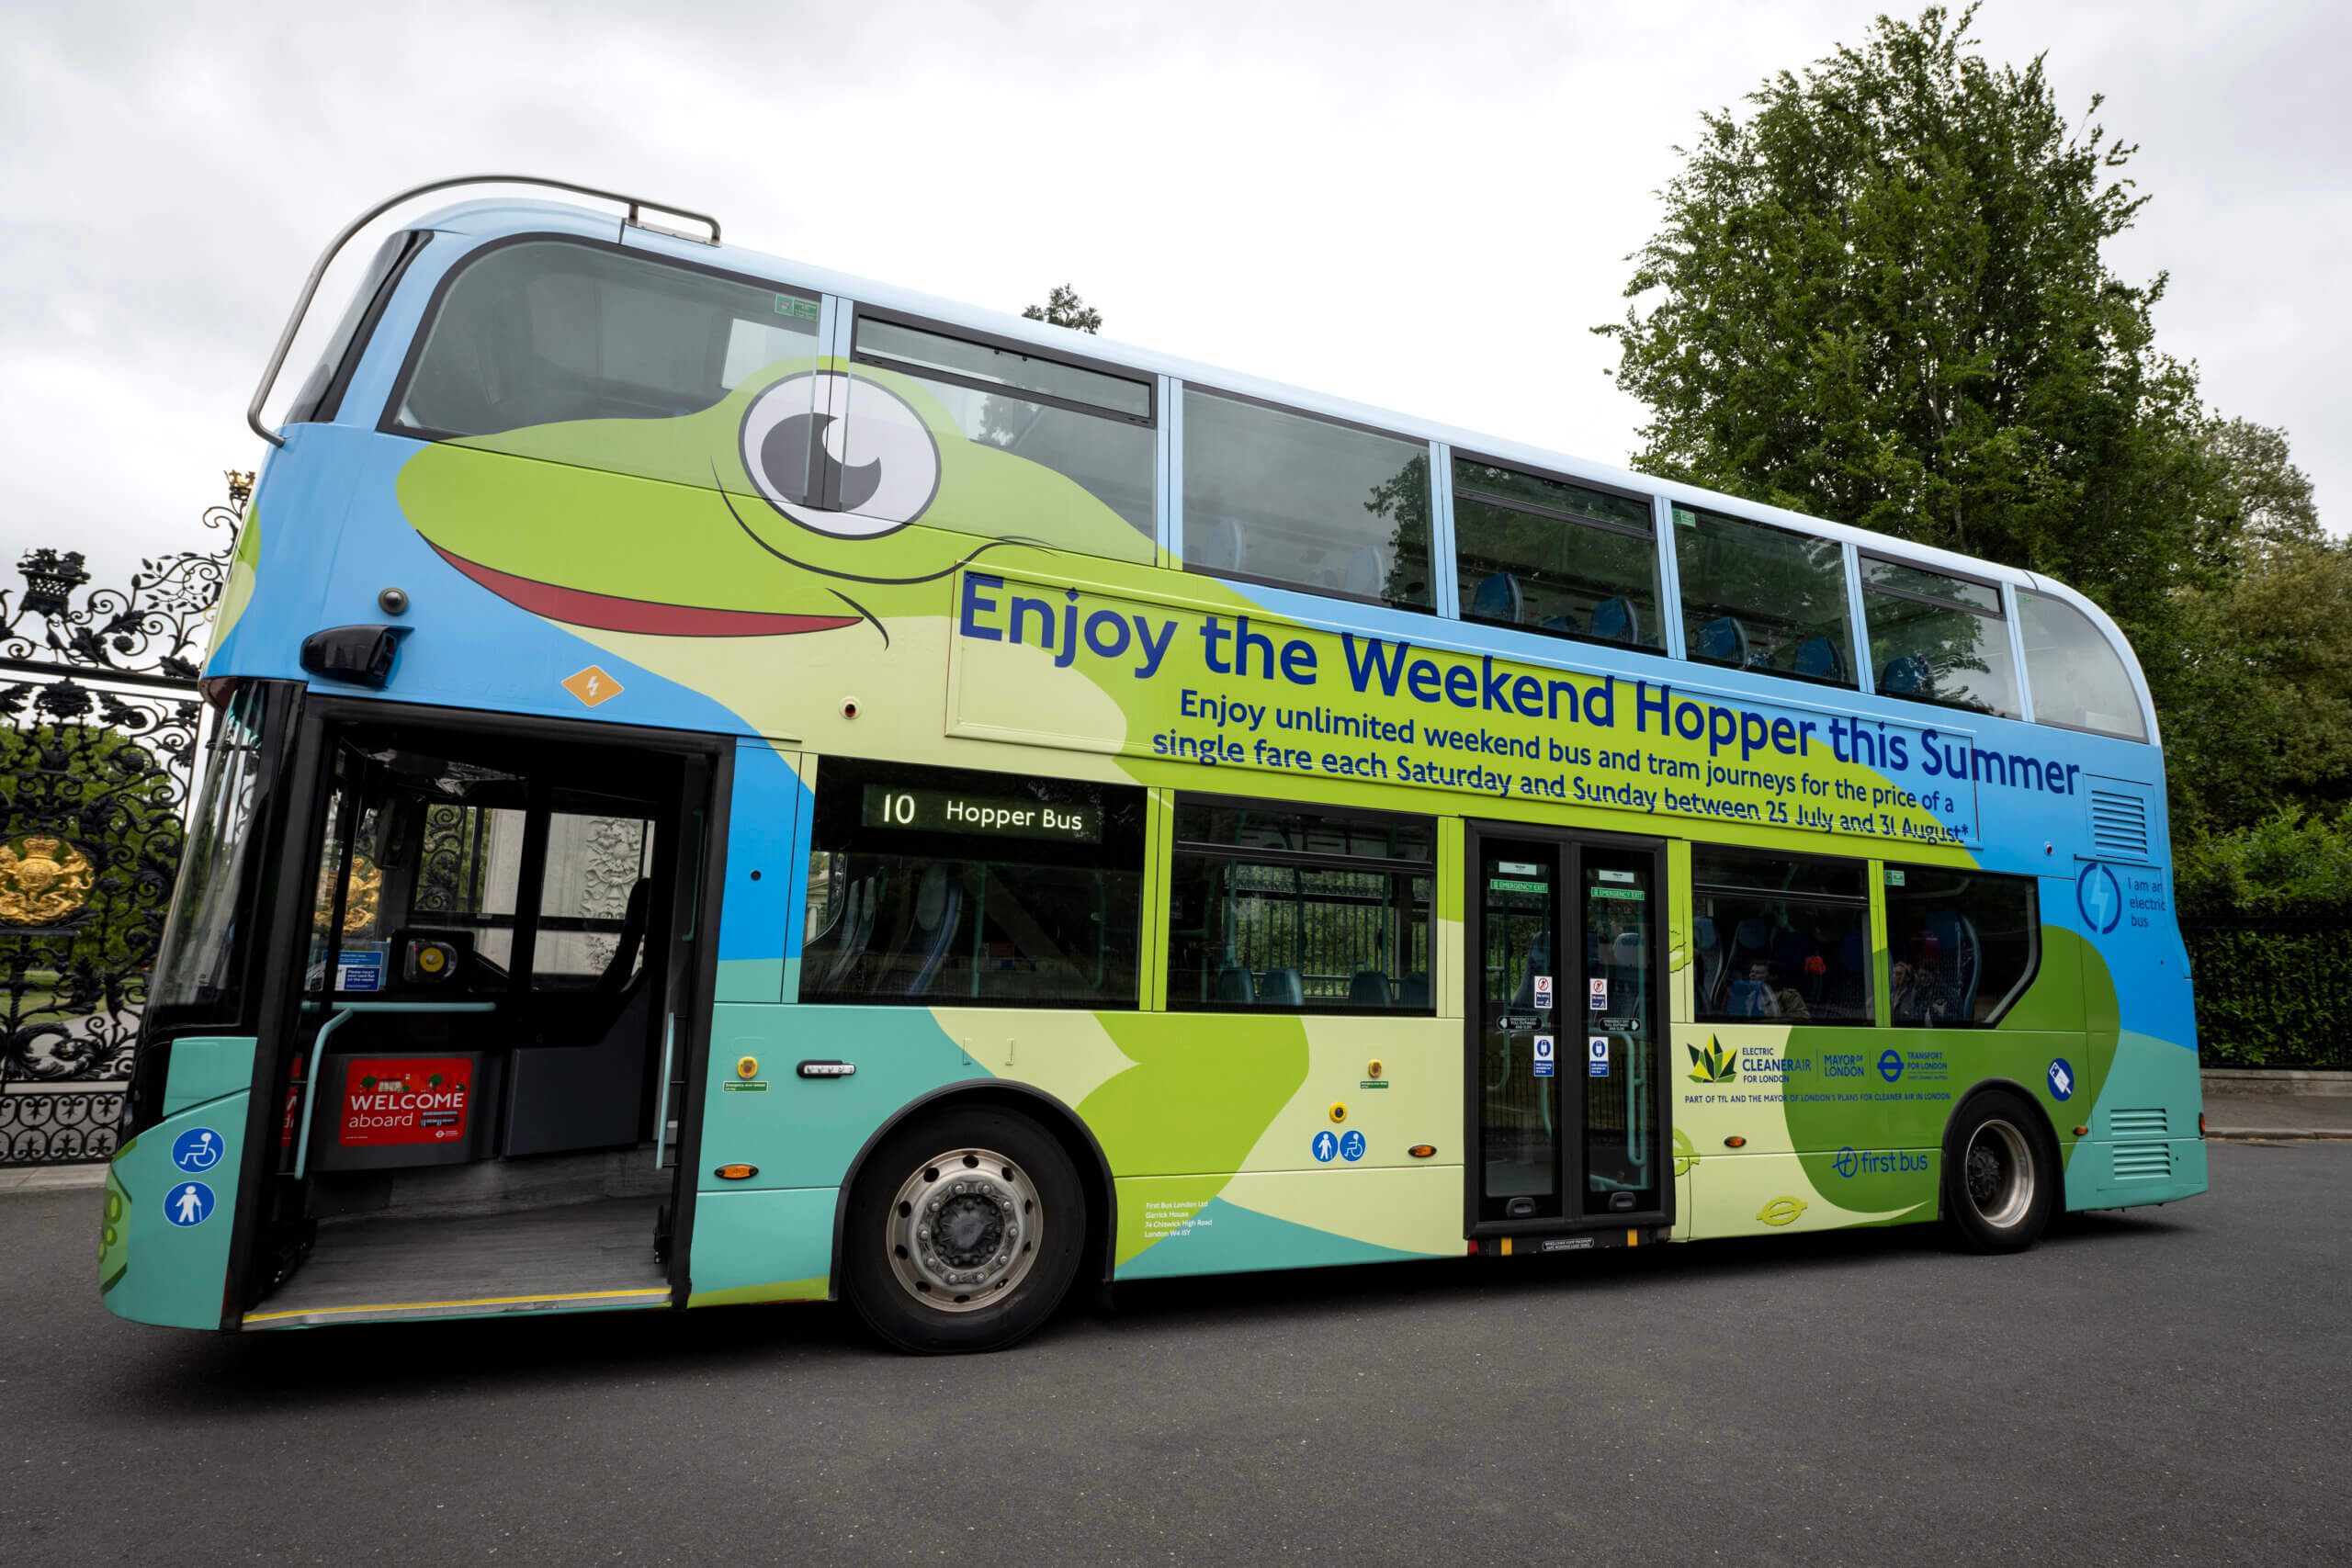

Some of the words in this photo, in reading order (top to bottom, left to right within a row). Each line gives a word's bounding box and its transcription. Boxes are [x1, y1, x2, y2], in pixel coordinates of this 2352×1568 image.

[960, 570, 1179, 680] Enjoy
[1199, 615, 1317, 685] the
[1341, 631, 1615, 728] Weekend
[1636, 680, 1816, 761] Hopper
[1829, 716, 1909, 772] this
[1921, 728, 2080, 795] Summer
[1181, 688, 1267, 731] Enjoy
[1275, 705, 1416, 744] unlimited
[1423, 728, 1541, 760] weekend
[1549, 737, 1592, 766] bus
[1598, 749, 1641, 773] and
[1647, 752, 1700, 781] tram
[1705, 760, 1796, 796] journeys
[1801, 773, 1830, 797] for
[1835, 778, 1867, 802] the
[1872, 784, 1917, 809] price
[1921, 790, 1940, 813] of
[1944, 796, 1954, 814] a
[1152, 728, 1246, 766] single
[1253, 739, 1314, 771] fare
[1321, 751, 1388, 779] each
[1396, 755, 1512, 797] Saturday
[1520, 773, 1566, 798] and
[1572, 776, 1657, 814] Sunday
[1664, 787, 1762, 821] between
[1765, 800, 1788, 824] 25
[1794, 803, 1834, 834] July
[1839, 813, 1876, 834] and
[1879, 814, 1897, 837] 31
[883, 793, 916, 824] 10
[945, 800, 1036, 829] Hopper
[1042, 808, 1082, 830] Bus
[1498, 881, 1532, 890] EMERGENCY
[2128, 877, 2132, 889] I
[2133, 881, 2149, 891] am
[1599, 889, 1630, 897] EMERGENCY
[2130, 897, 2166, 911] electric
[2131, 914, 2148, 928] bus
[1742, 1046, 1774, 1056] ELECTRIC
[1906, 1051, 1943, 1060] TRANSPORT
[1824, 1054, 1855, 1066] MAYOR
[1856, 1054, 1864, 1062] OF
[1907, 1062, 1918, 1070] FOR
[1919, 1062, 1948, 1070] LONDON
[1825, 1066, 1865, 1077] LONDON
[1743, 1075, 1758, 1084] FOR
[1758, 1075, 1791, 1084] LONDON
[351, 1092, 465, 1111] WELCOME
[1685, 1095, 1703, 1104] PART
[1705, 1094, 1715, 1103] OF
[1718, 1094, 1729, 1103] TfL
[1731, 1094, 1747, 1103] AND
[1748, 1094, 1762, 1103] THE
[1763, 1094, 1788, 1103] MAYOR
[1790, 1094, 1799, 1102] OF
[1838, 1094, 1859, 1102] PLANS
[1860, 1093, 1872, 1102] FOR
[1874, 1093, 1903, 1101] CLEANER
[1904, 1092, 1914, 1101] AIR
[1916, 1092, 1923, 1100] IN
[1924, 1092, 1951, 1100] LONDON
[348, 1111, 413, 1129] aboard
[1860, 1151, 1896, 1174] first
[1899, 1149, 1928, 1172] bus
[1173, 1201, 1197, 1209] London
[1182, 1219, 1196, 1228] High
[1197, 1219, 1213, 1227] Road
[1170, 1229, 1181, 1237] W4
